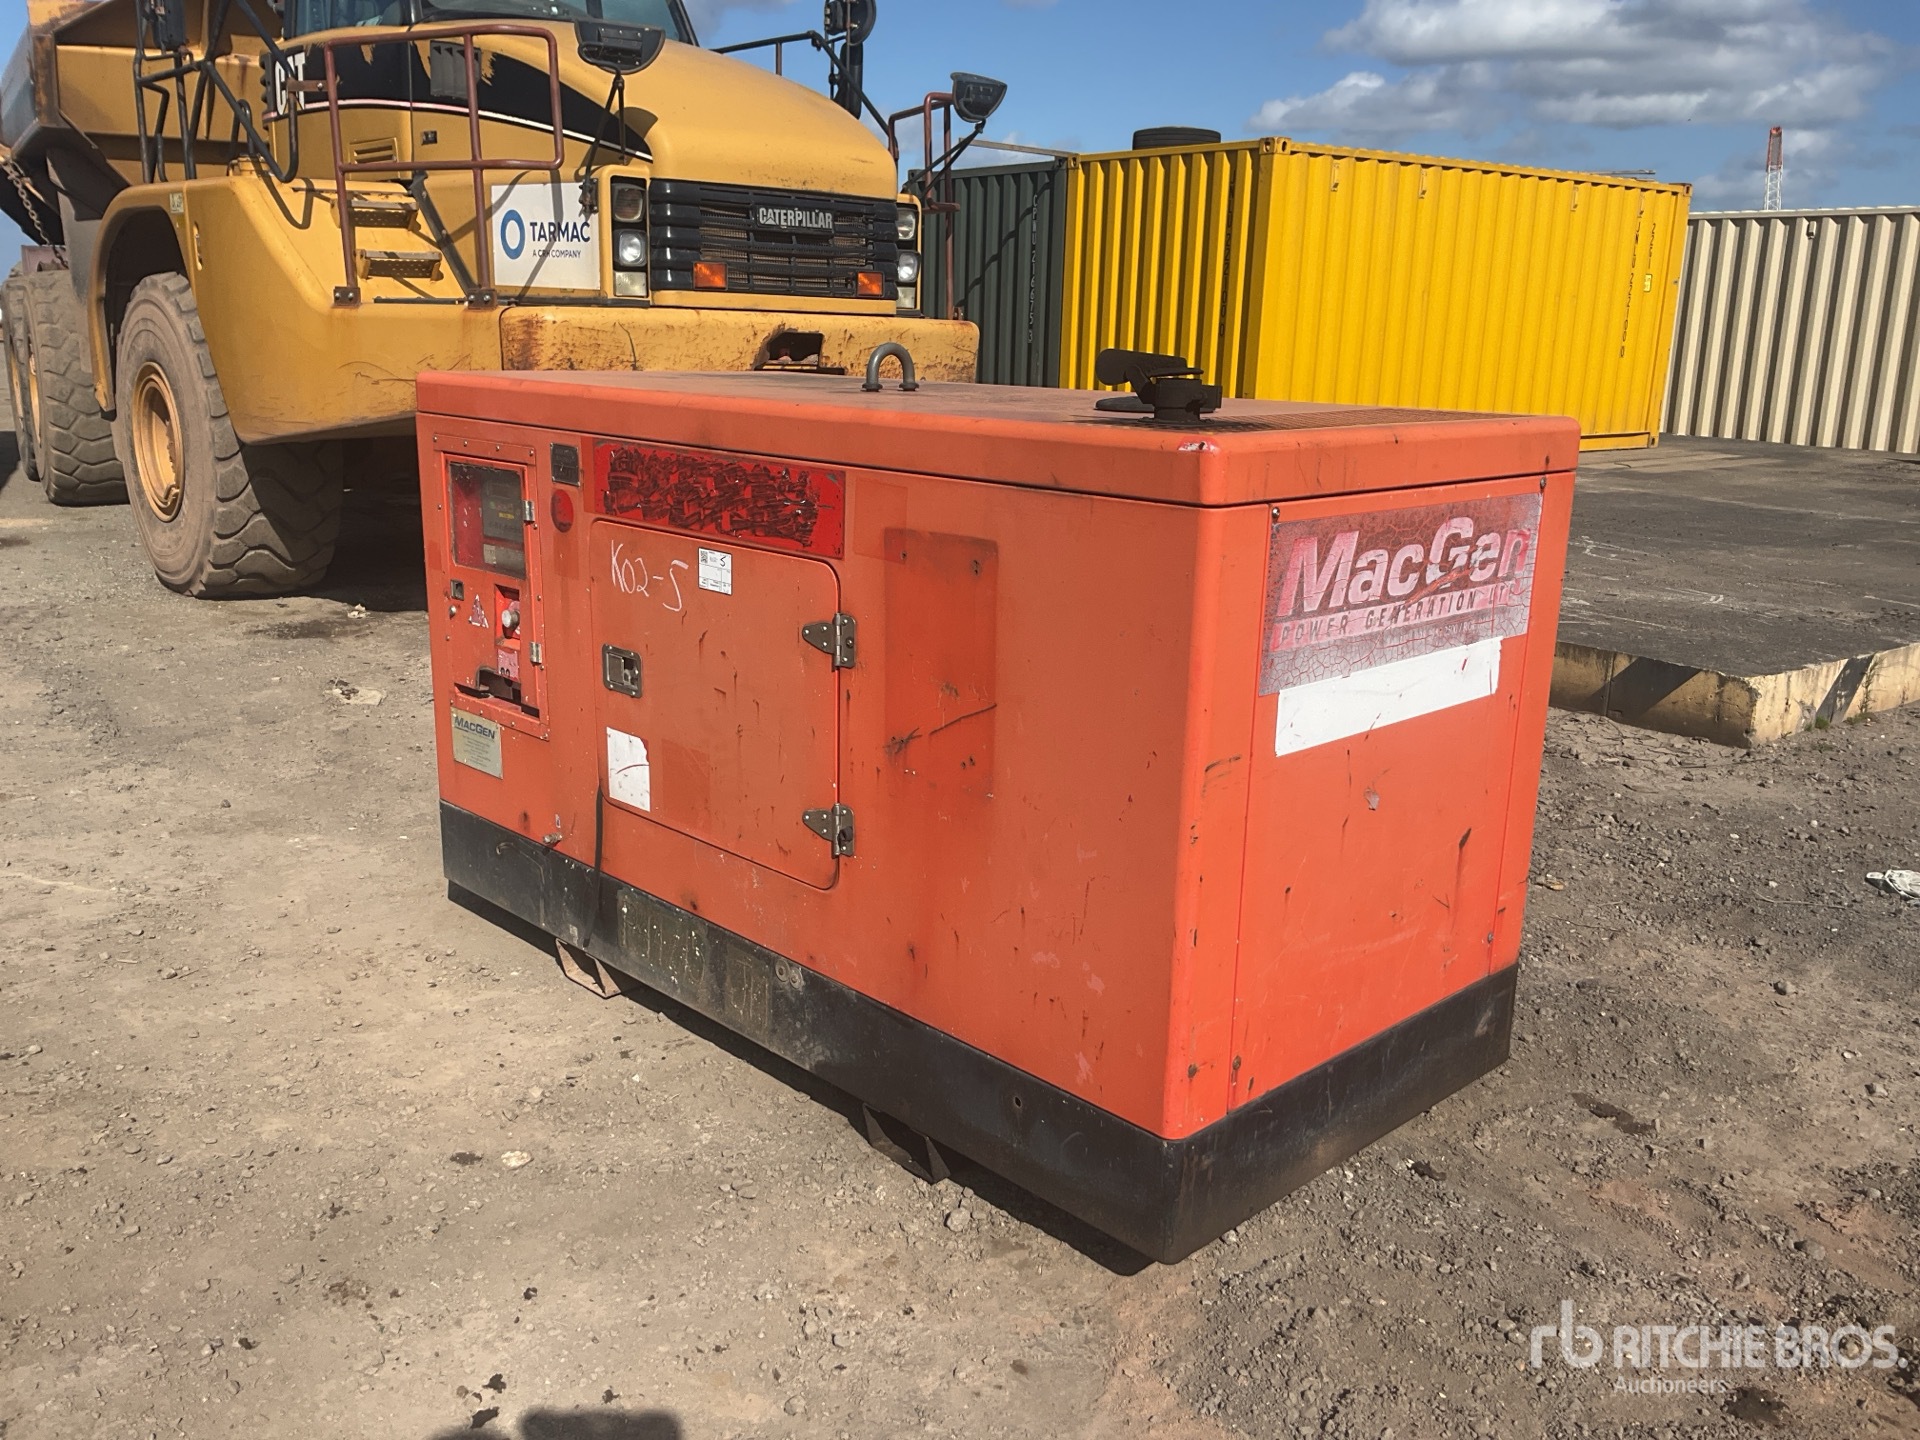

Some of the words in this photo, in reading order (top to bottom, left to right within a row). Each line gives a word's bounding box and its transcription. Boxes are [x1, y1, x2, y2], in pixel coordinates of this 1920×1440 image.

[275, 52, 306, 115] CT
[530, 221, 591, 243] TARMAC
[759, 206, 833, 229] CATERPILLAR
[532, 249, 537, 257] A
[538, 249, 550, 258] CRH
[551, 249, 582, 258] COMPANY
[1275, 516, 1532, 617] MacGen
[1365, 590, 1477, 630] GENERATION
